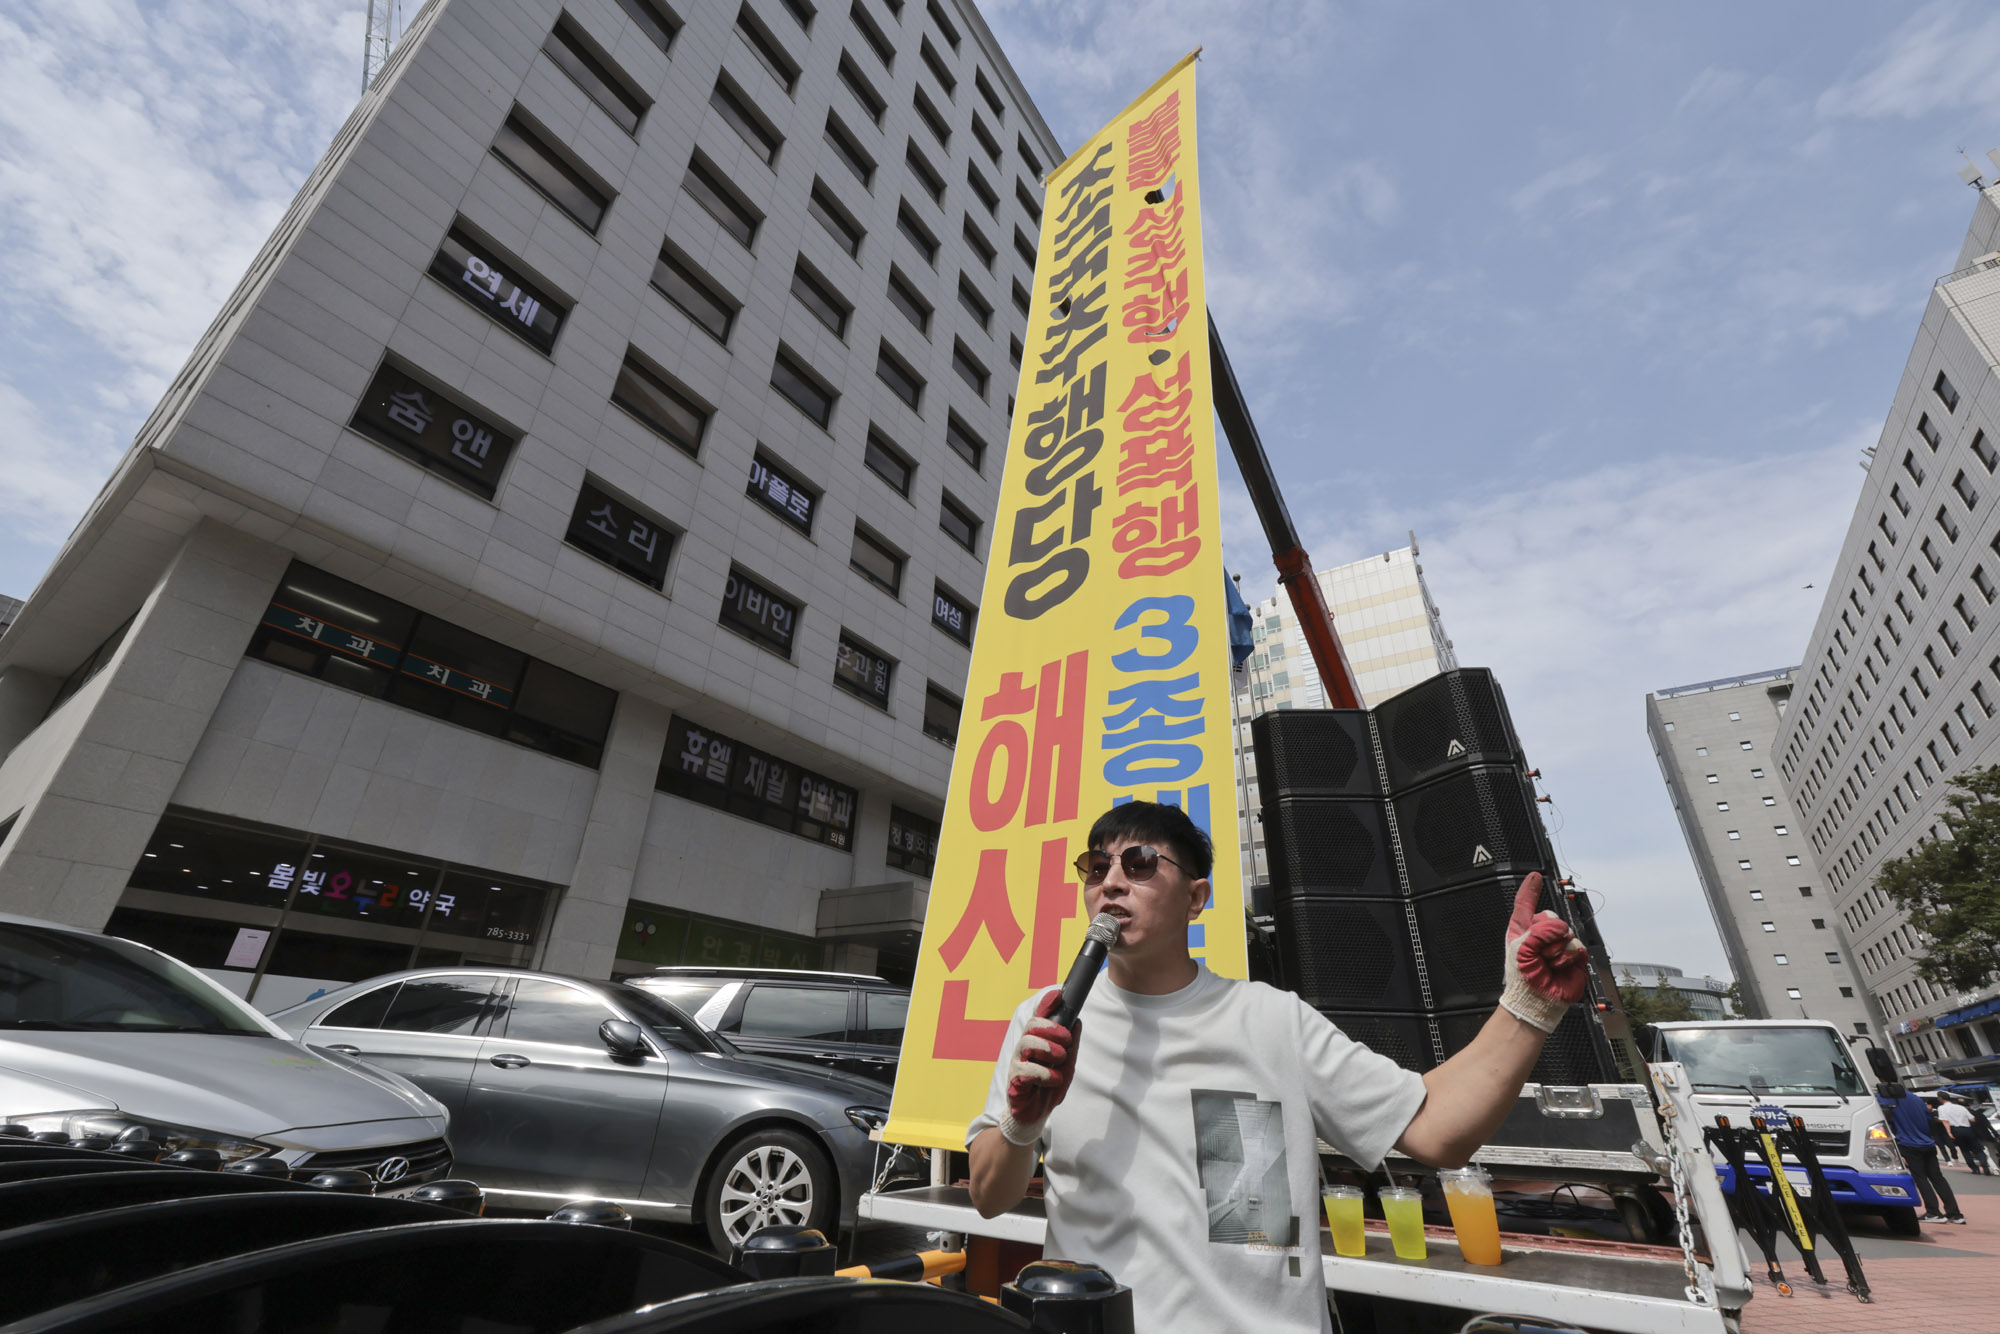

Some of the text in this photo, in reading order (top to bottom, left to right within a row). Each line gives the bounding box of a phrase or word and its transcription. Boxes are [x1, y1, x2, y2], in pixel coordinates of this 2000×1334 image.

[462, 256, 541, 327] 연세
[749, 460, 810, 522] 아폴로
[586, 503, 658, 562] 소리
[725, 575, 792, 638] 이비인
[932, 141, 1115, 1063] 조국추행당 해산
[935, 596, 962, 630] 여성
[295, 617, 492, 699] 치과 치과
[680, 730, 731, 784] 휴엘
[744, 756, 790, 805] 재활
[830, 832, 846, 846] 의원
[487, 927, 530, 941] 785-3331
[1770, 1153, 1792, 1198] POLICE
[1790, 1206, 1806, 1237] LINE
